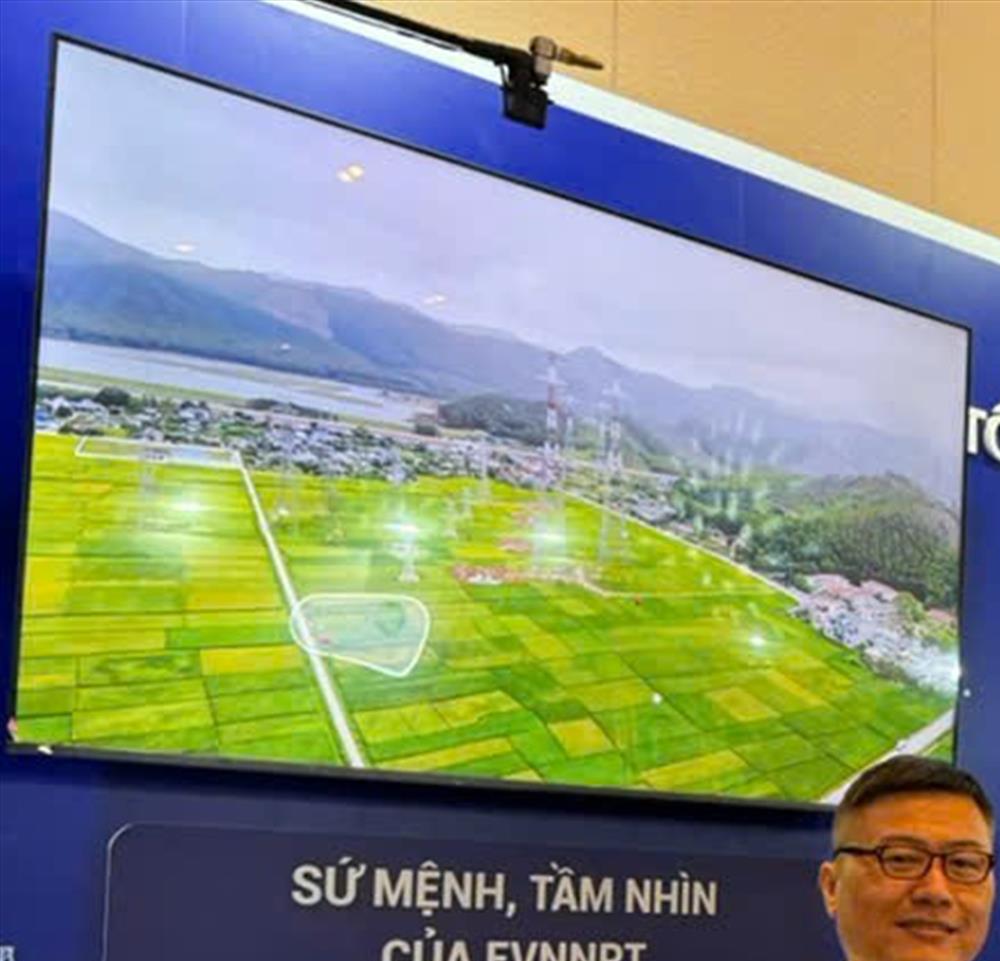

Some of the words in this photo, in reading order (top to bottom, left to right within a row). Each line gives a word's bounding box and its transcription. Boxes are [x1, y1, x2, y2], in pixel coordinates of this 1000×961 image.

[291, 856, 367, 907] SỨ
[373, 860, 517, 918] MỆNH,
[530, 862, 614, 913] TẦM
[625, 872, 718, 916] NHÌN
